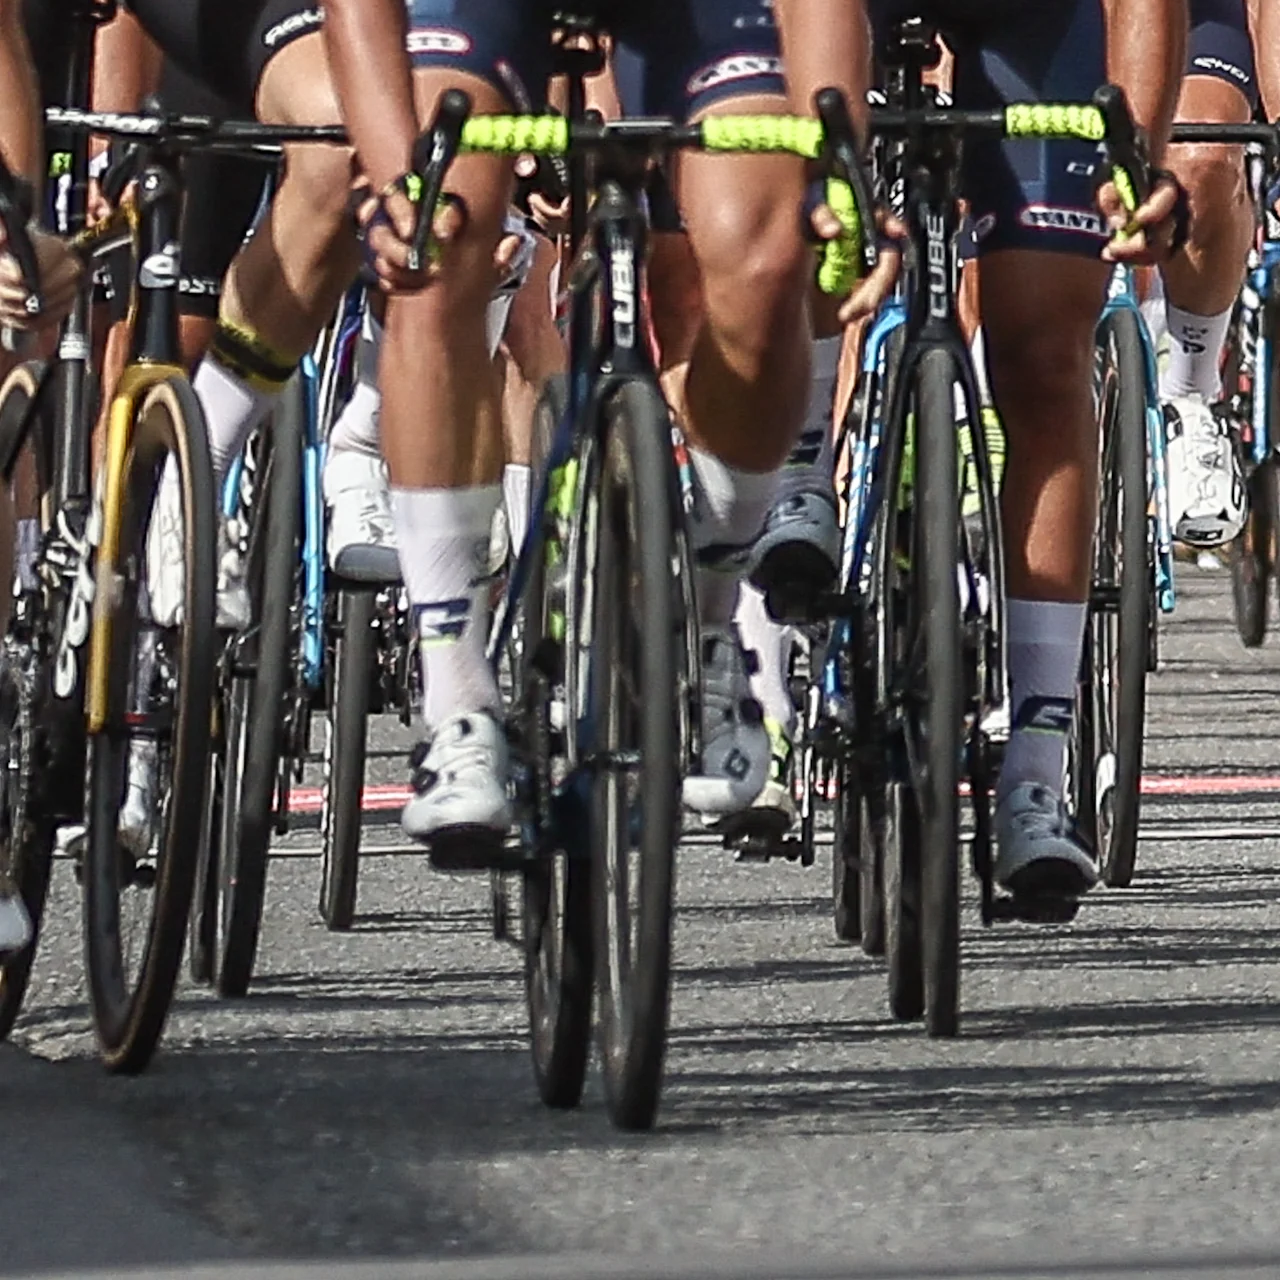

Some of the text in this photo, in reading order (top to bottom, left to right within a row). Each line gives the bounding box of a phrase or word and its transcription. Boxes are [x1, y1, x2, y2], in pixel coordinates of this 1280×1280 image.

[265, 8, 325, 46] AGU
[611, 236, 636, 349] CUBE
[926, 213, 949, 319] CUBE
